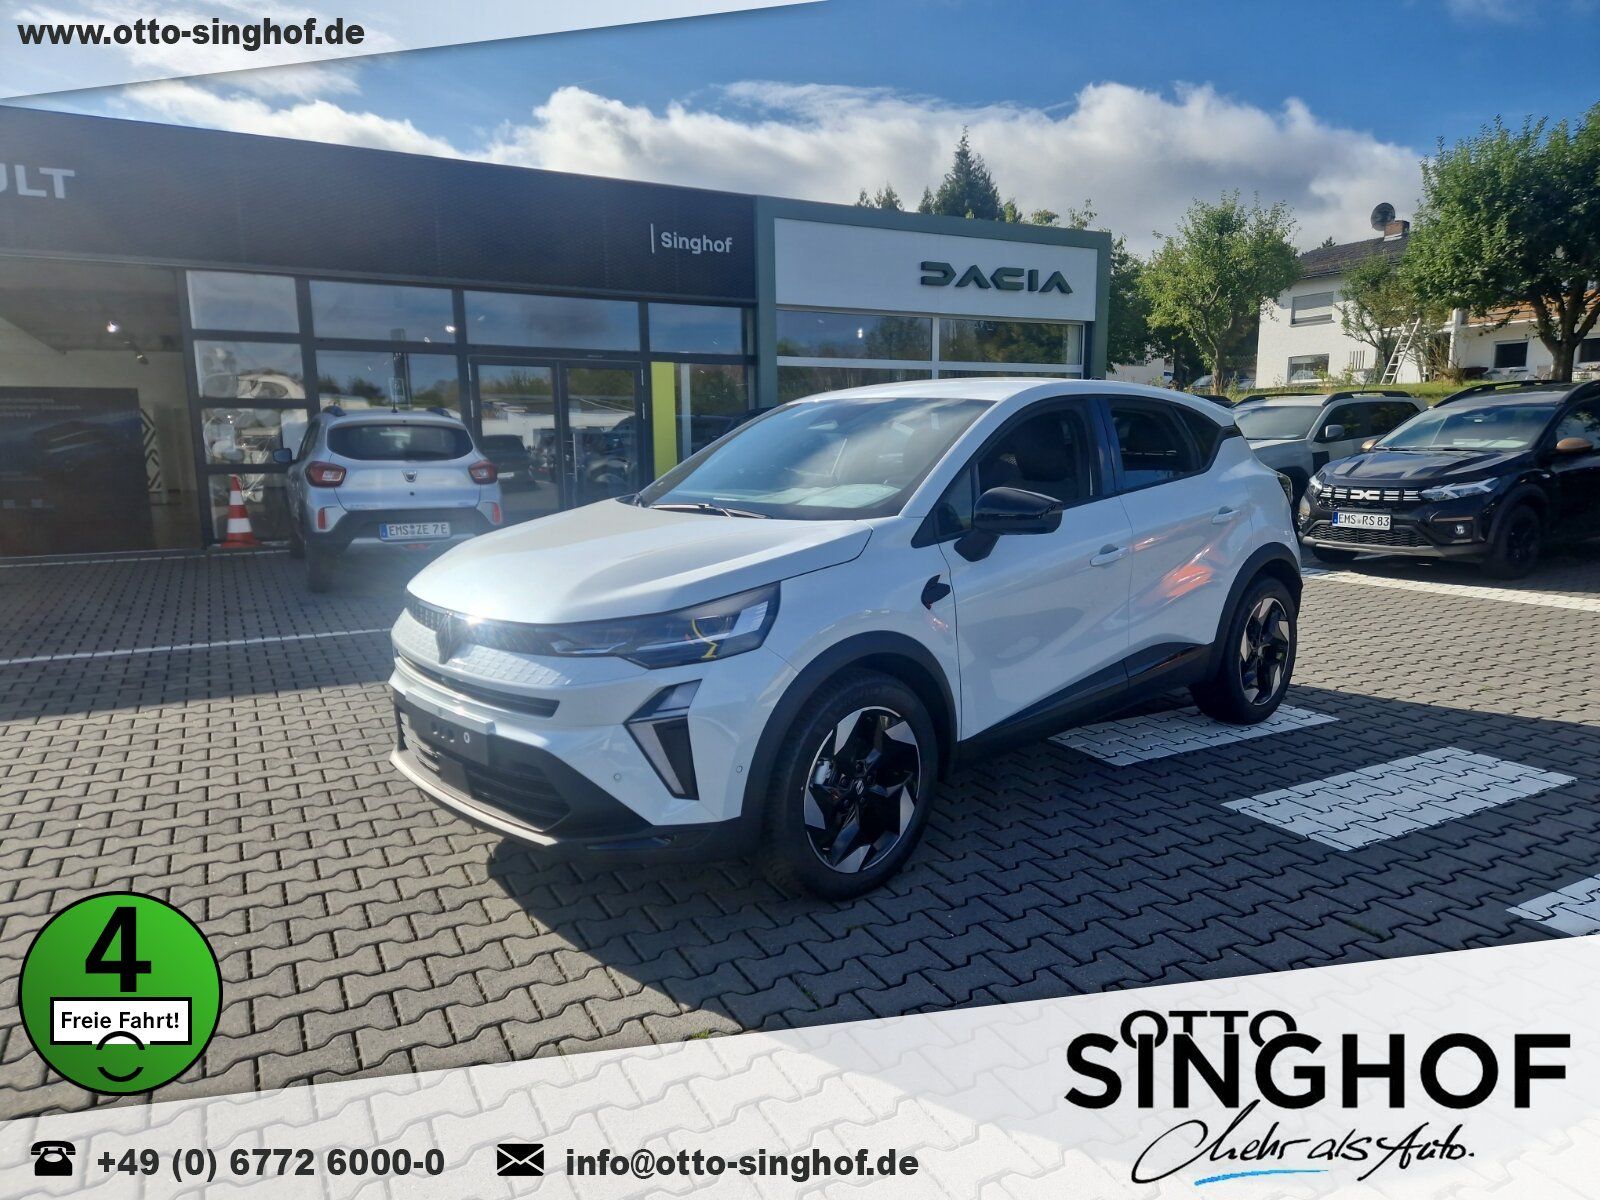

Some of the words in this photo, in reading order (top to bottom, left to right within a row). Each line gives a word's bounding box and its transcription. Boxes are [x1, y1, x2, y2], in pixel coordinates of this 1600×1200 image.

[0, 163, 75, 199] LT
[660, 231, 733, 254] Singhof
[920, 260, 1074, 294] DACIA
[388, 524, 409, 536] EMS
[416, 524, 430, 535] ZE
[1338, 513, 1356, 525] EMS
[1362, 515, 1375, 526] RS
[1377, 516, 1390, 526] 83
